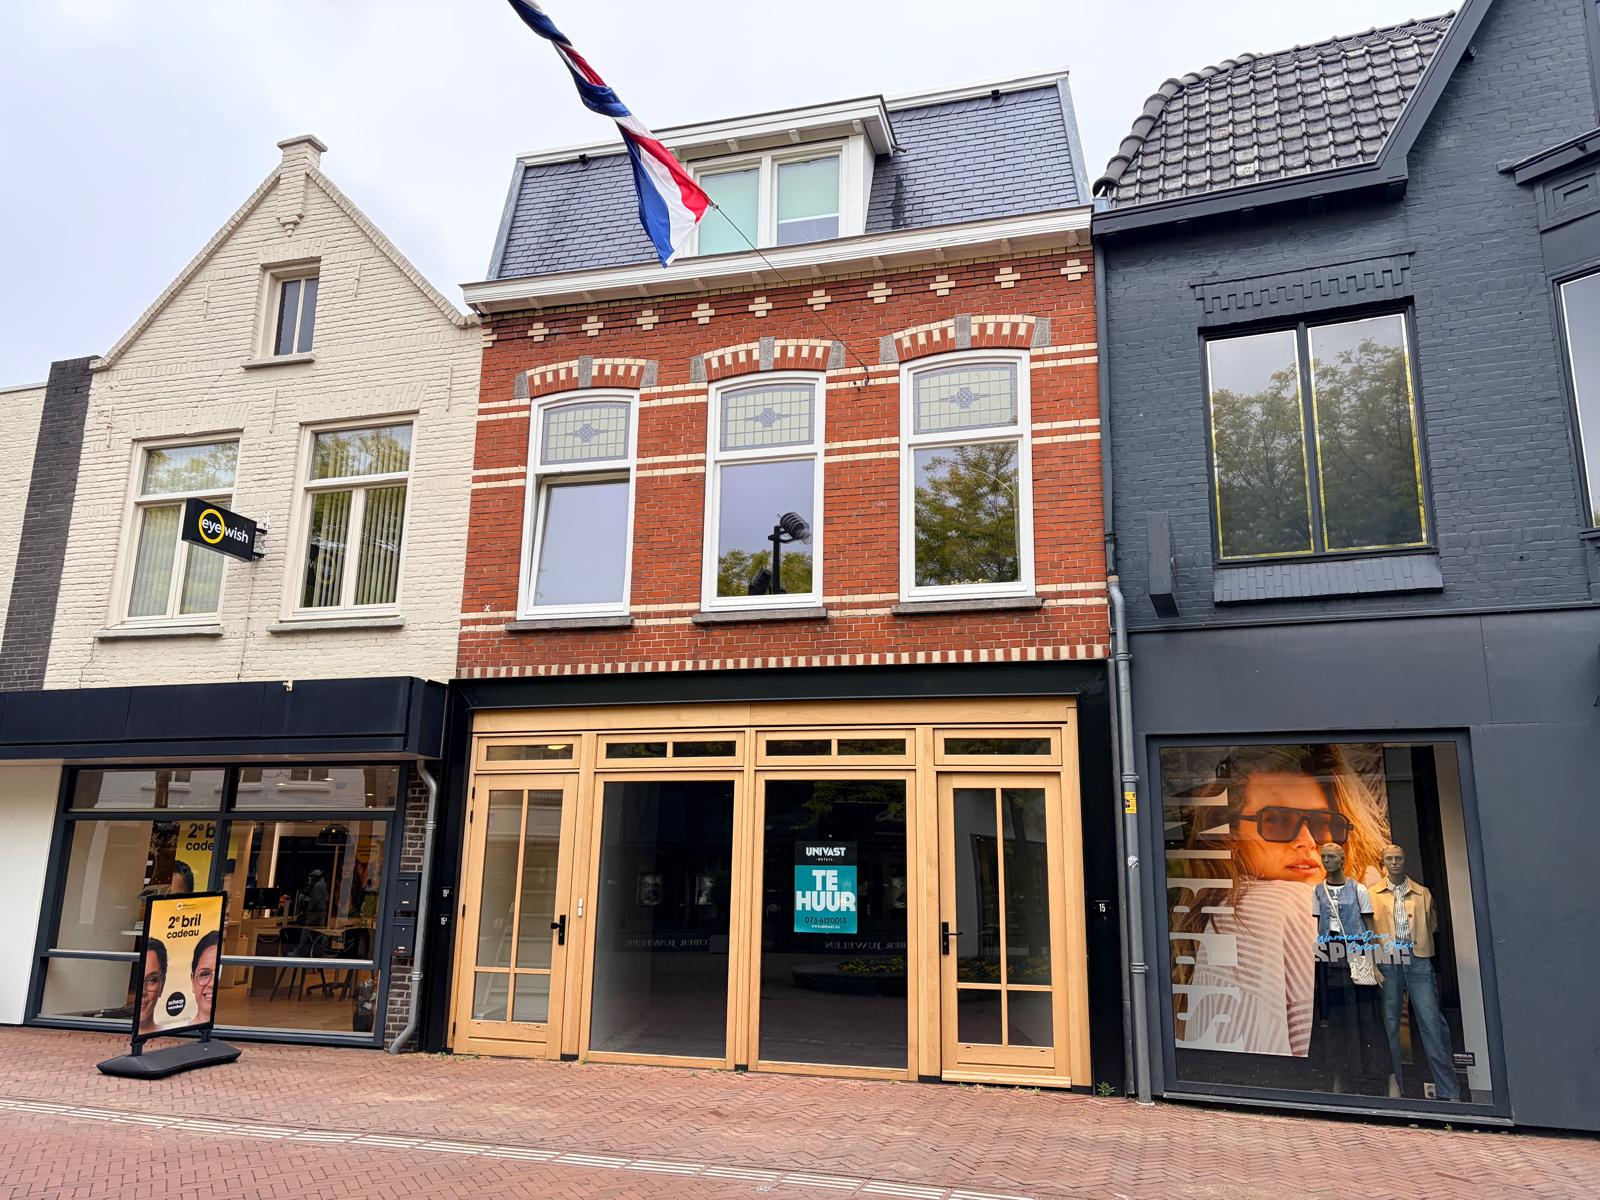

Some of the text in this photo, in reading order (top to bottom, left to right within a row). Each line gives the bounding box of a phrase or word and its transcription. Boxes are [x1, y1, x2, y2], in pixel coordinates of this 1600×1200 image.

[805, 846, 847, 857] UNIVAST
[812, 869, 838, 891] TE
[795, 890, 856, 912] HUUR
[1098, 903, 1106, 912] 15
[181, 913, 202, 928] bril
[167, 929, 200, 939] cadeau
